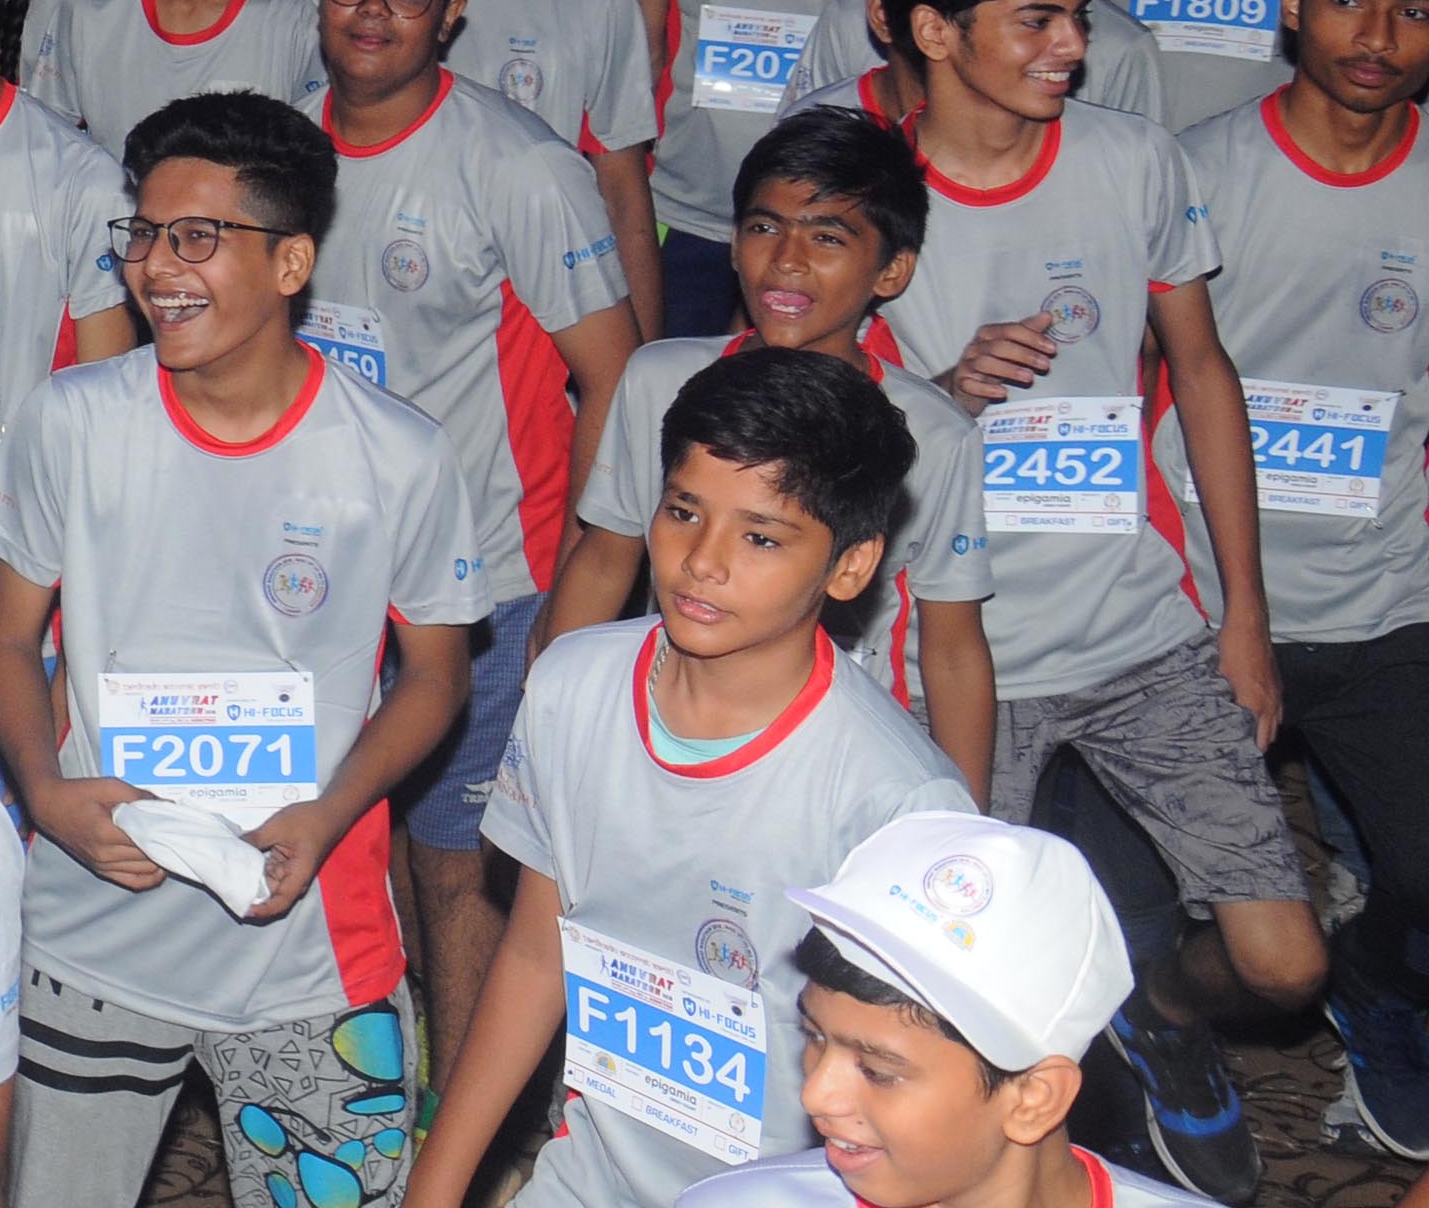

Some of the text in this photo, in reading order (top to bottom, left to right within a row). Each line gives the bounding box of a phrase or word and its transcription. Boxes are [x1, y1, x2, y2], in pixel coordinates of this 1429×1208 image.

[704, 45, 799, 82] F207
[1072, 423, 1128, 435] HI-FOCUS
[1327, 410, 1381, 424] HI-FOCUS
[984, 446, 1123, 487] 2452
[1253, 427, 1365, 471] 2441
[1015, 494, 1071, 507] epigamia
[150, 695, 219, 707] ANUVRAT
[243, 706, 303, 718] HI-FOCUS
[112, 734, 293, 778] F2071
[188, 786, 247, 801] epigamia
[610, 957, 674, 992] ANUVRAT
[696, 1003, 757, 1041] HI-FOCUS
[576, 986, 752, 1104] F1134
[643, 1072, 698, 1107] epigamia
[585, 1076, 749, 1161] MEDAL BREAKFAST GIFT
